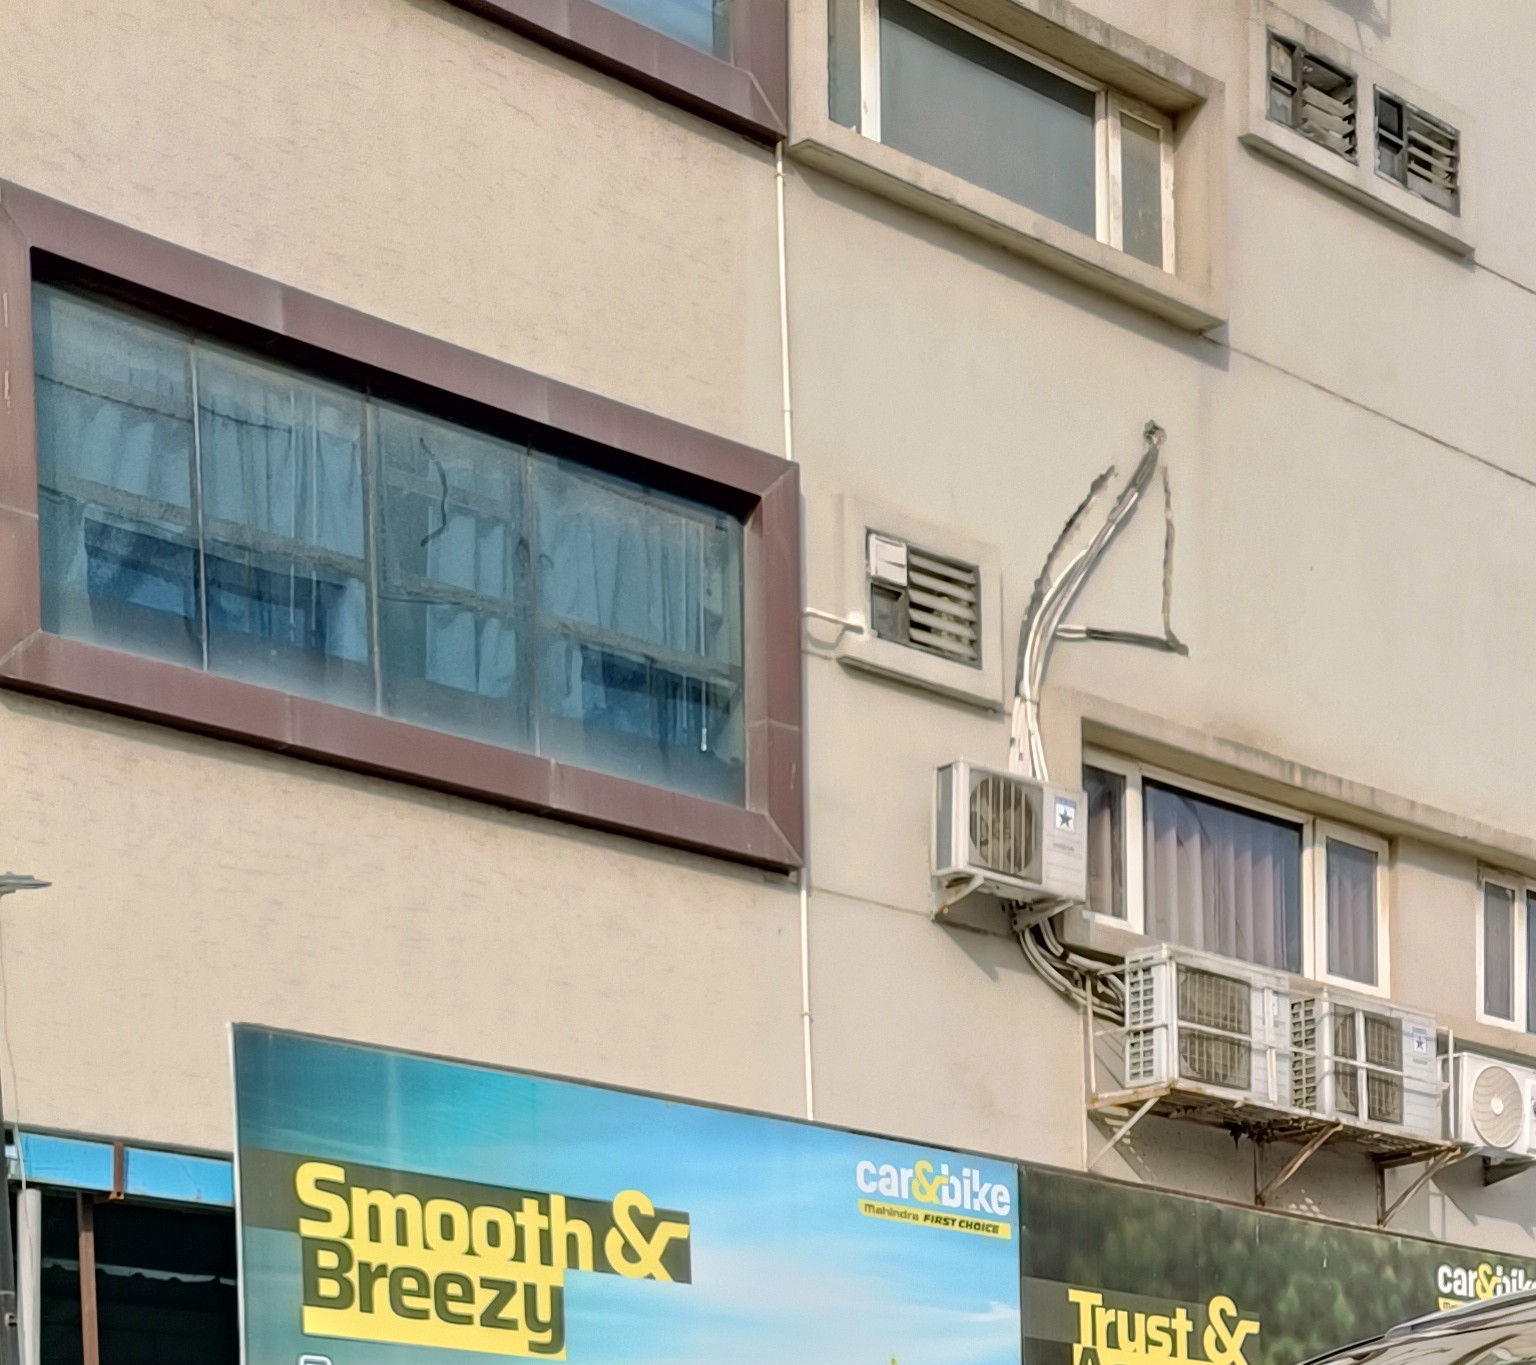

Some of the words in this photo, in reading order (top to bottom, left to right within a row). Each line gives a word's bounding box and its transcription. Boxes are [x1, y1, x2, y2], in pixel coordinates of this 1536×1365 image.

[295, 1161, 594, 1271] Smooth
[604, 1189, 690, 1282] &
[856, 1160, 1011, 1216] car&bike
[864, 1203, 919, 1221] Mahindra
[923, 1214, 957, 1227] FIRST
[958, 1218, 1000, 1235] CHOICE
[302, 1236, 566, 1355] Breezy
[1068, 1288, 1194, 1360] Trust
